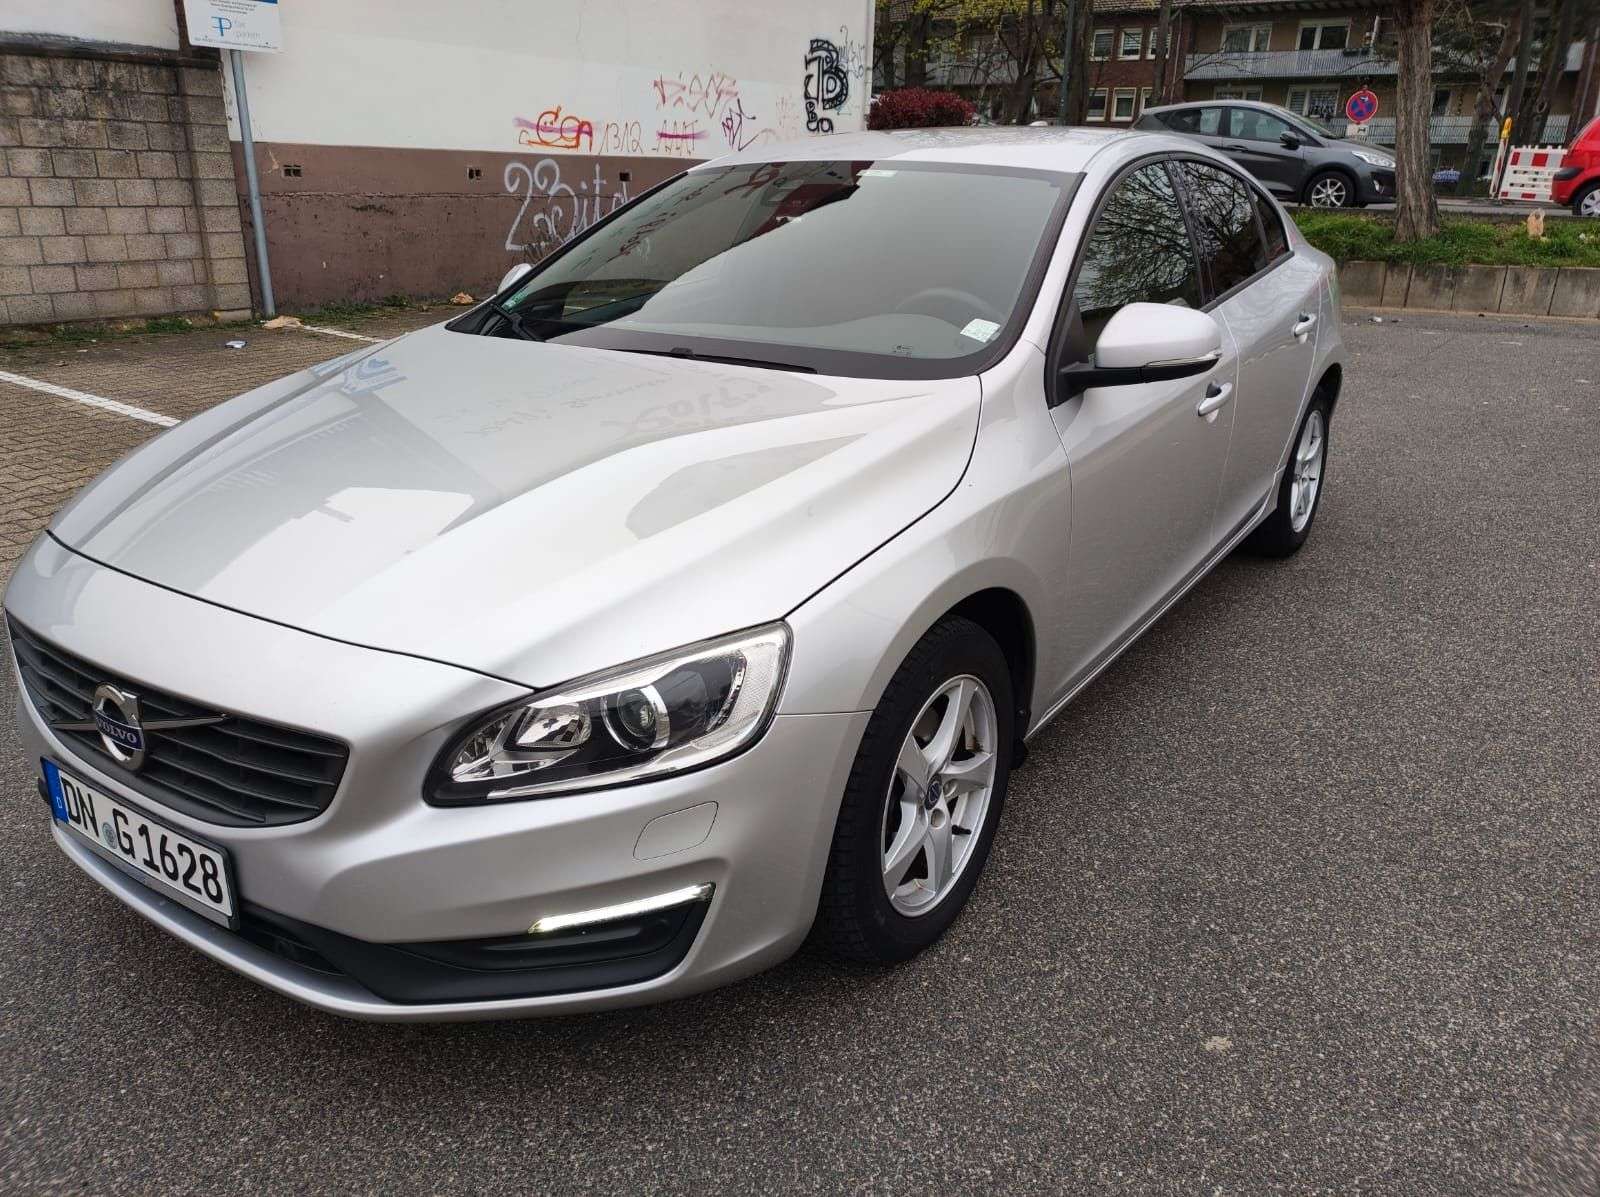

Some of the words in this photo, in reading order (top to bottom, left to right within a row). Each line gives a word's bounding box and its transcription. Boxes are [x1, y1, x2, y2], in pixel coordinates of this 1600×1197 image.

[599, 121, 643, 153] 1312
[97, 716, 137, 743] VOLVO
[60, 776, 99, 837] DN
